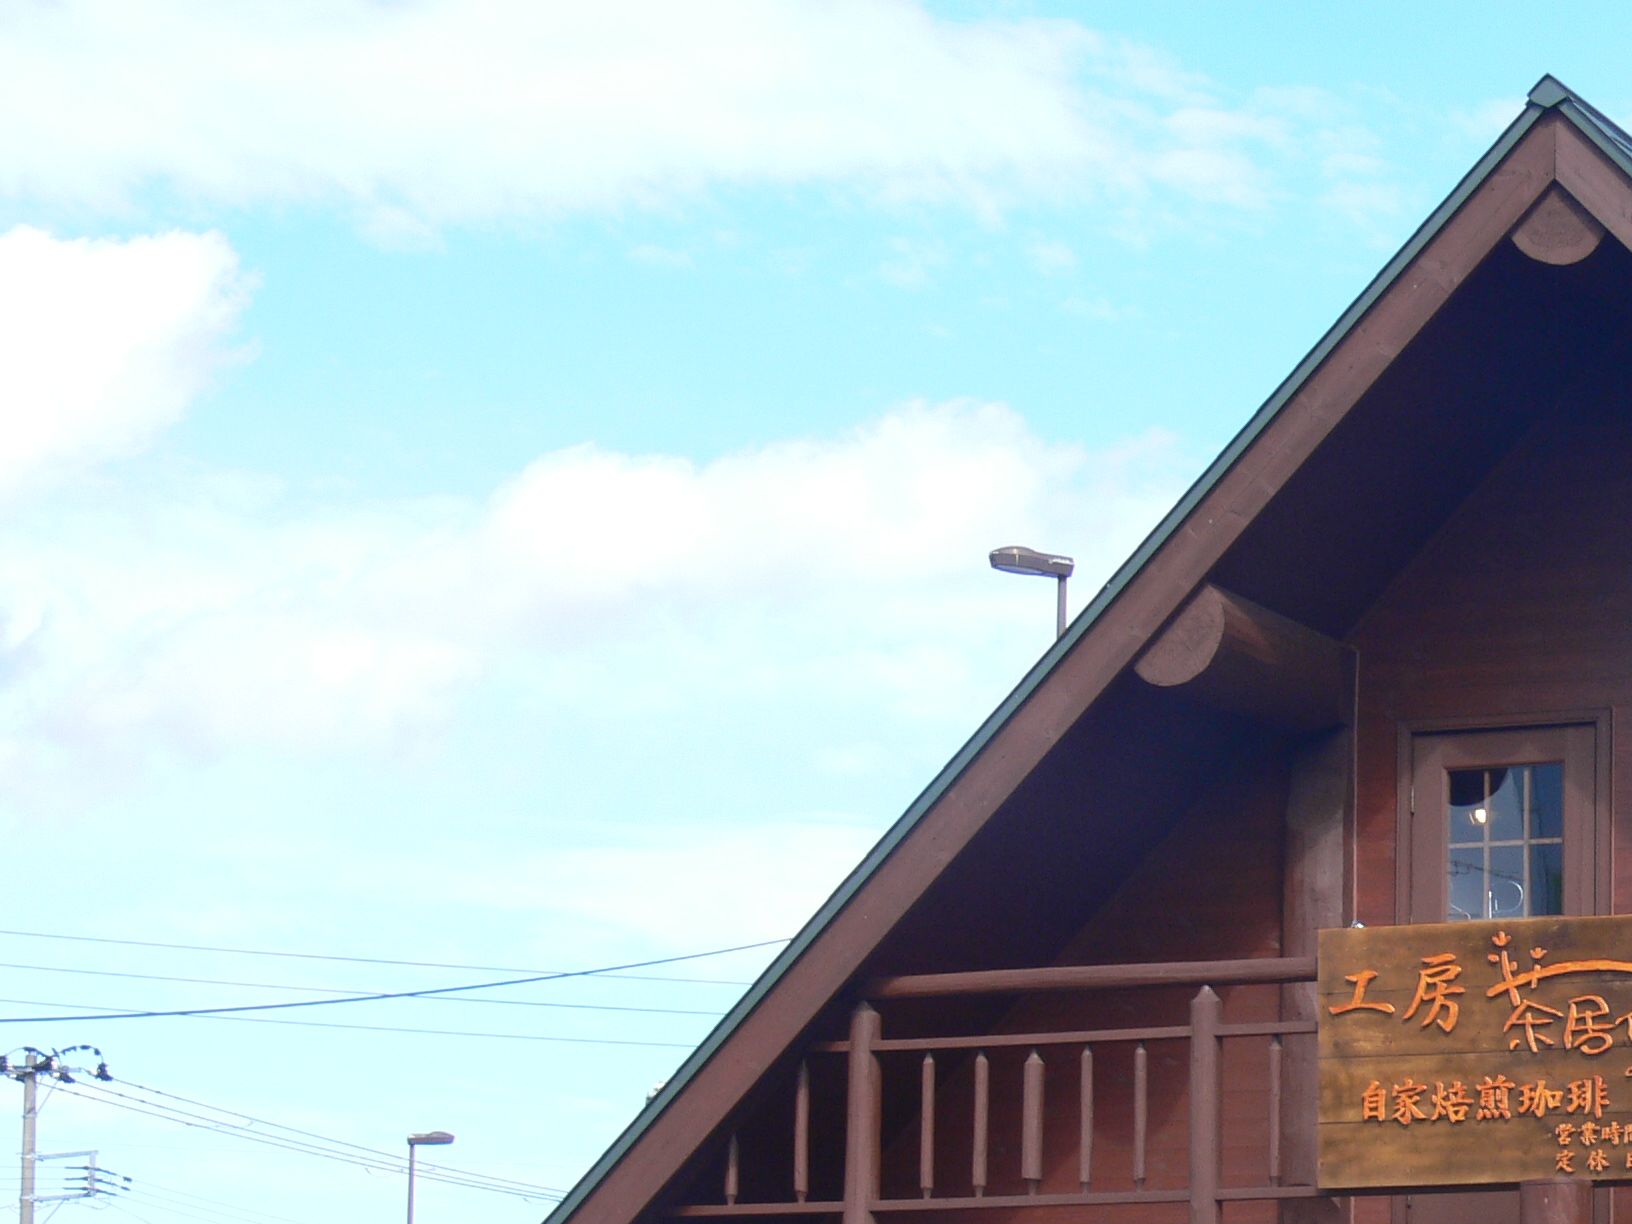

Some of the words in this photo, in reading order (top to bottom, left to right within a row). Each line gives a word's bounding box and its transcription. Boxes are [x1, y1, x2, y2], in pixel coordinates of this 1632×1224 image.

[1329, 952, 1466, 1033] 工房
[1361, 1074, 1610, 1125] 自家焙煎珈琲
